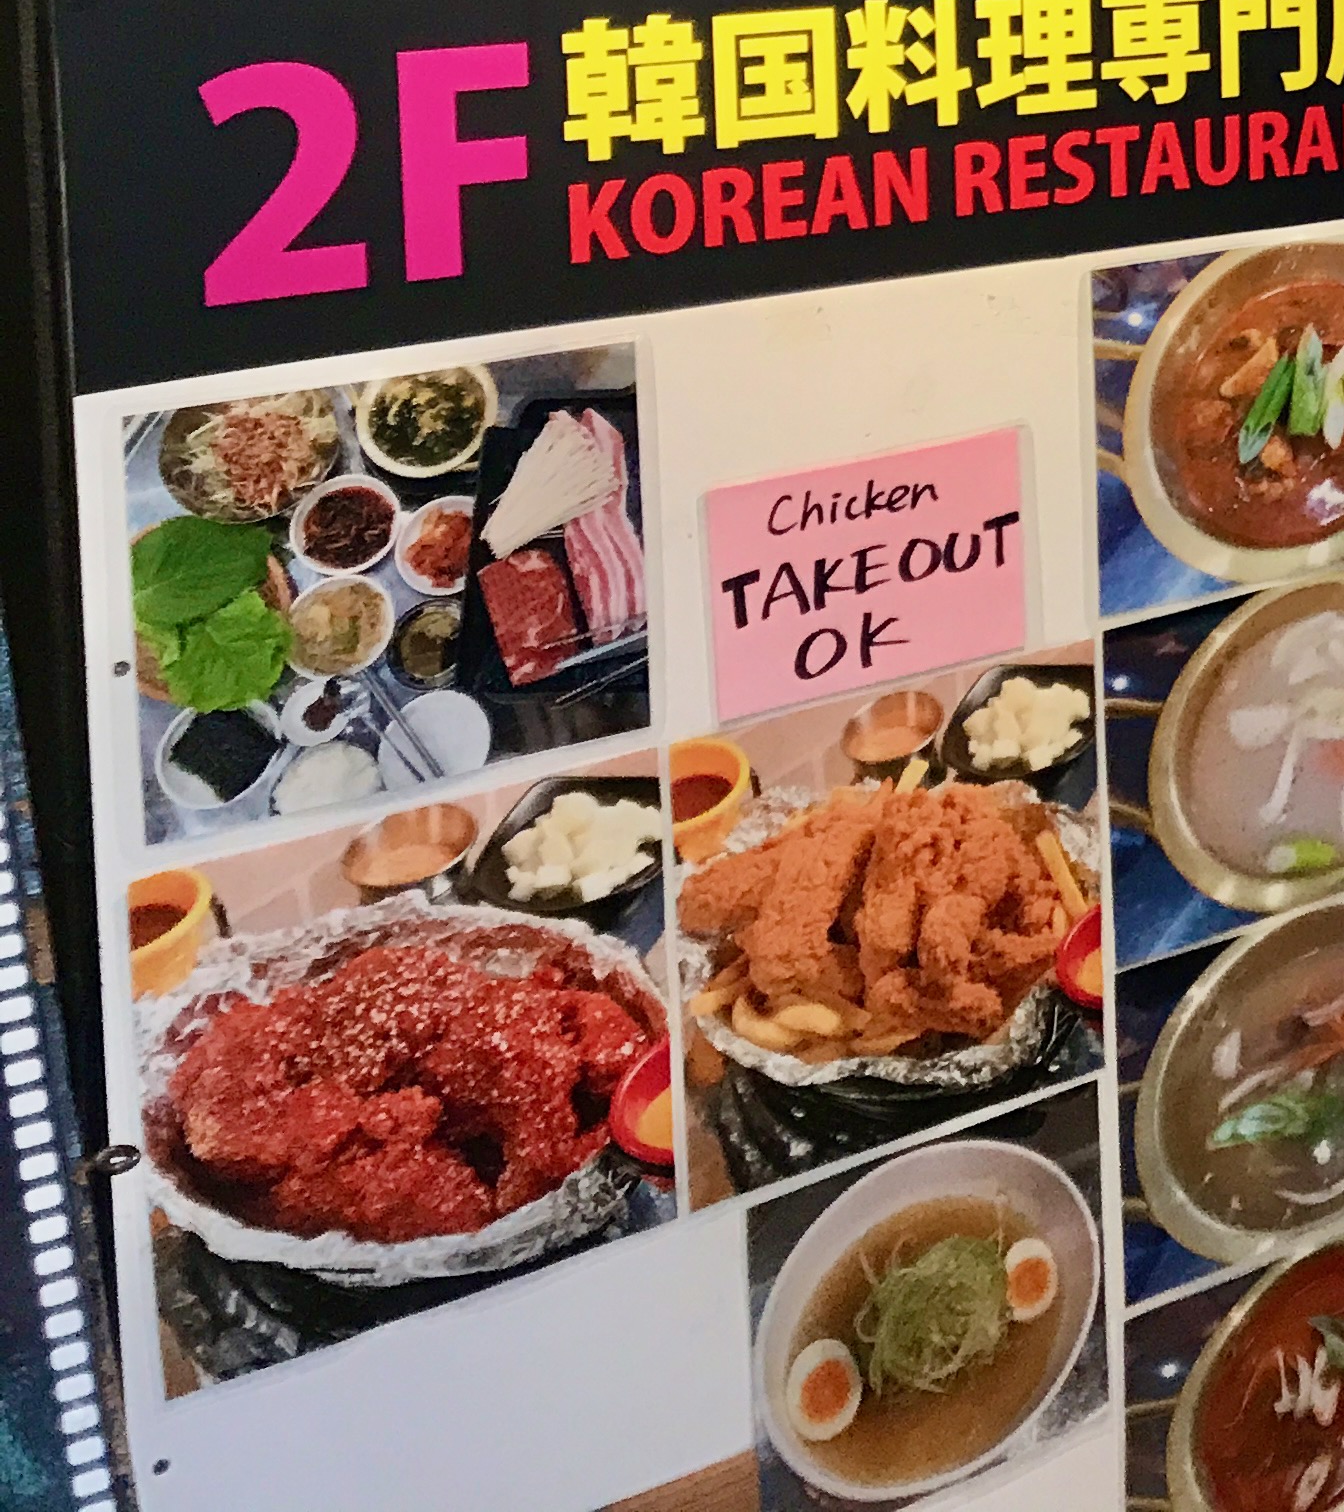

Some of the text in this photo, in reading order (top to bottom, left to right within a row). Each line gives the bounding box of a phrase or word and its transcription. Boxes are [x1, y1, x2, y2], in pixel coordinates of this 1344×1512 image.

[200, 42, 531, 308] 2F
[567, 145, 929, 265] KOREAN
[766, 479, 940, 536] Chicken
[793, 611, 911, 681] OK
